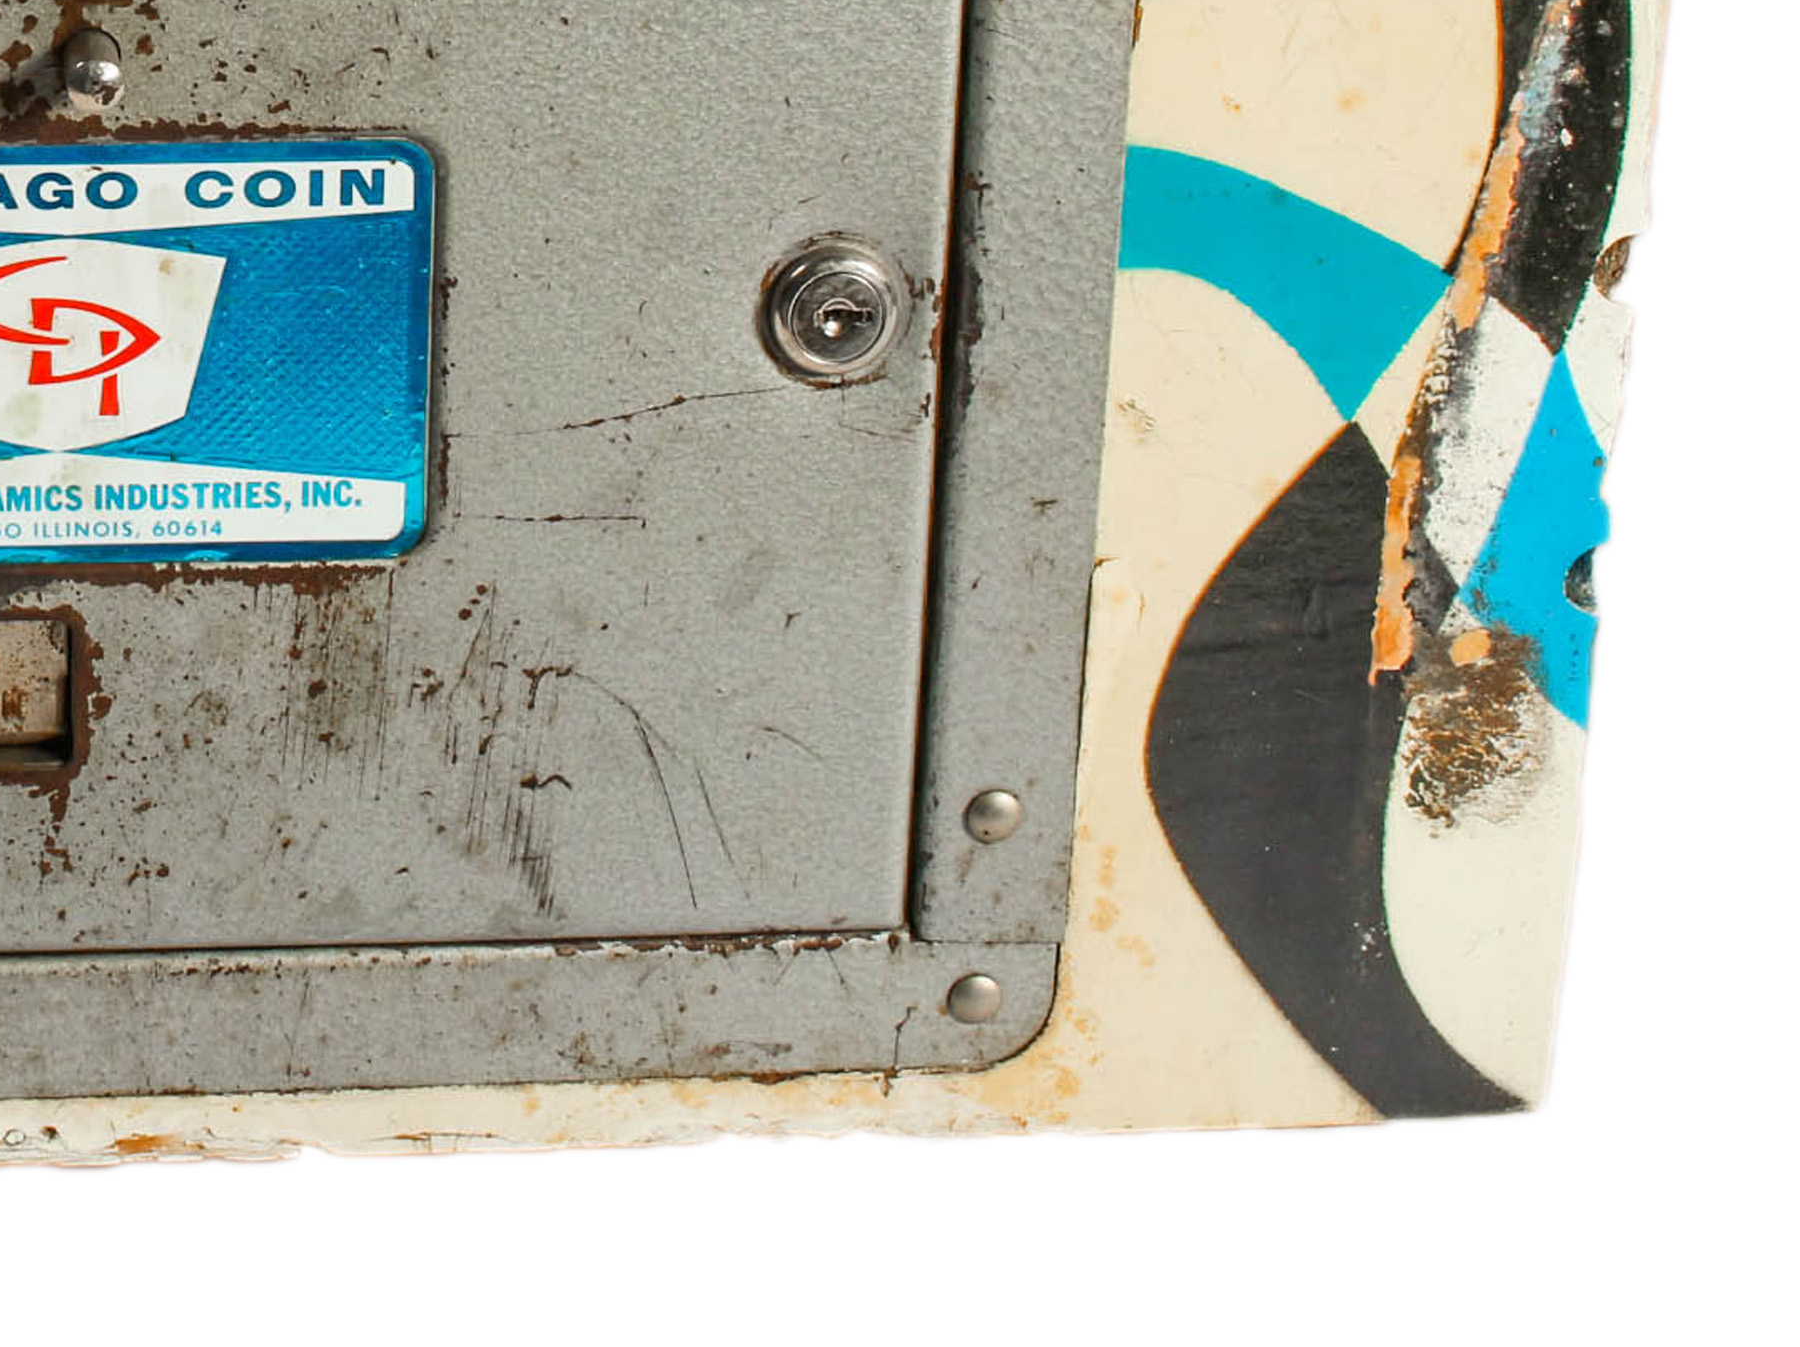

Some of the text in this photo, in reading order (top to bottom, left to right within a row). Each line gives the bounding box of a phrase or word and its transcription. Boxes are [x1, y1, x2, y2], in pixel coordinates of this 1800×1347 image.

[185, 168, 386, 208] COIN
[94, 481, 292, 513] INDUSTRIES,
[301, 478, 364, 509] INC.
[33, 520, 140, 540] ILLINOIS,
[152, 520, 223, 537] 60614
